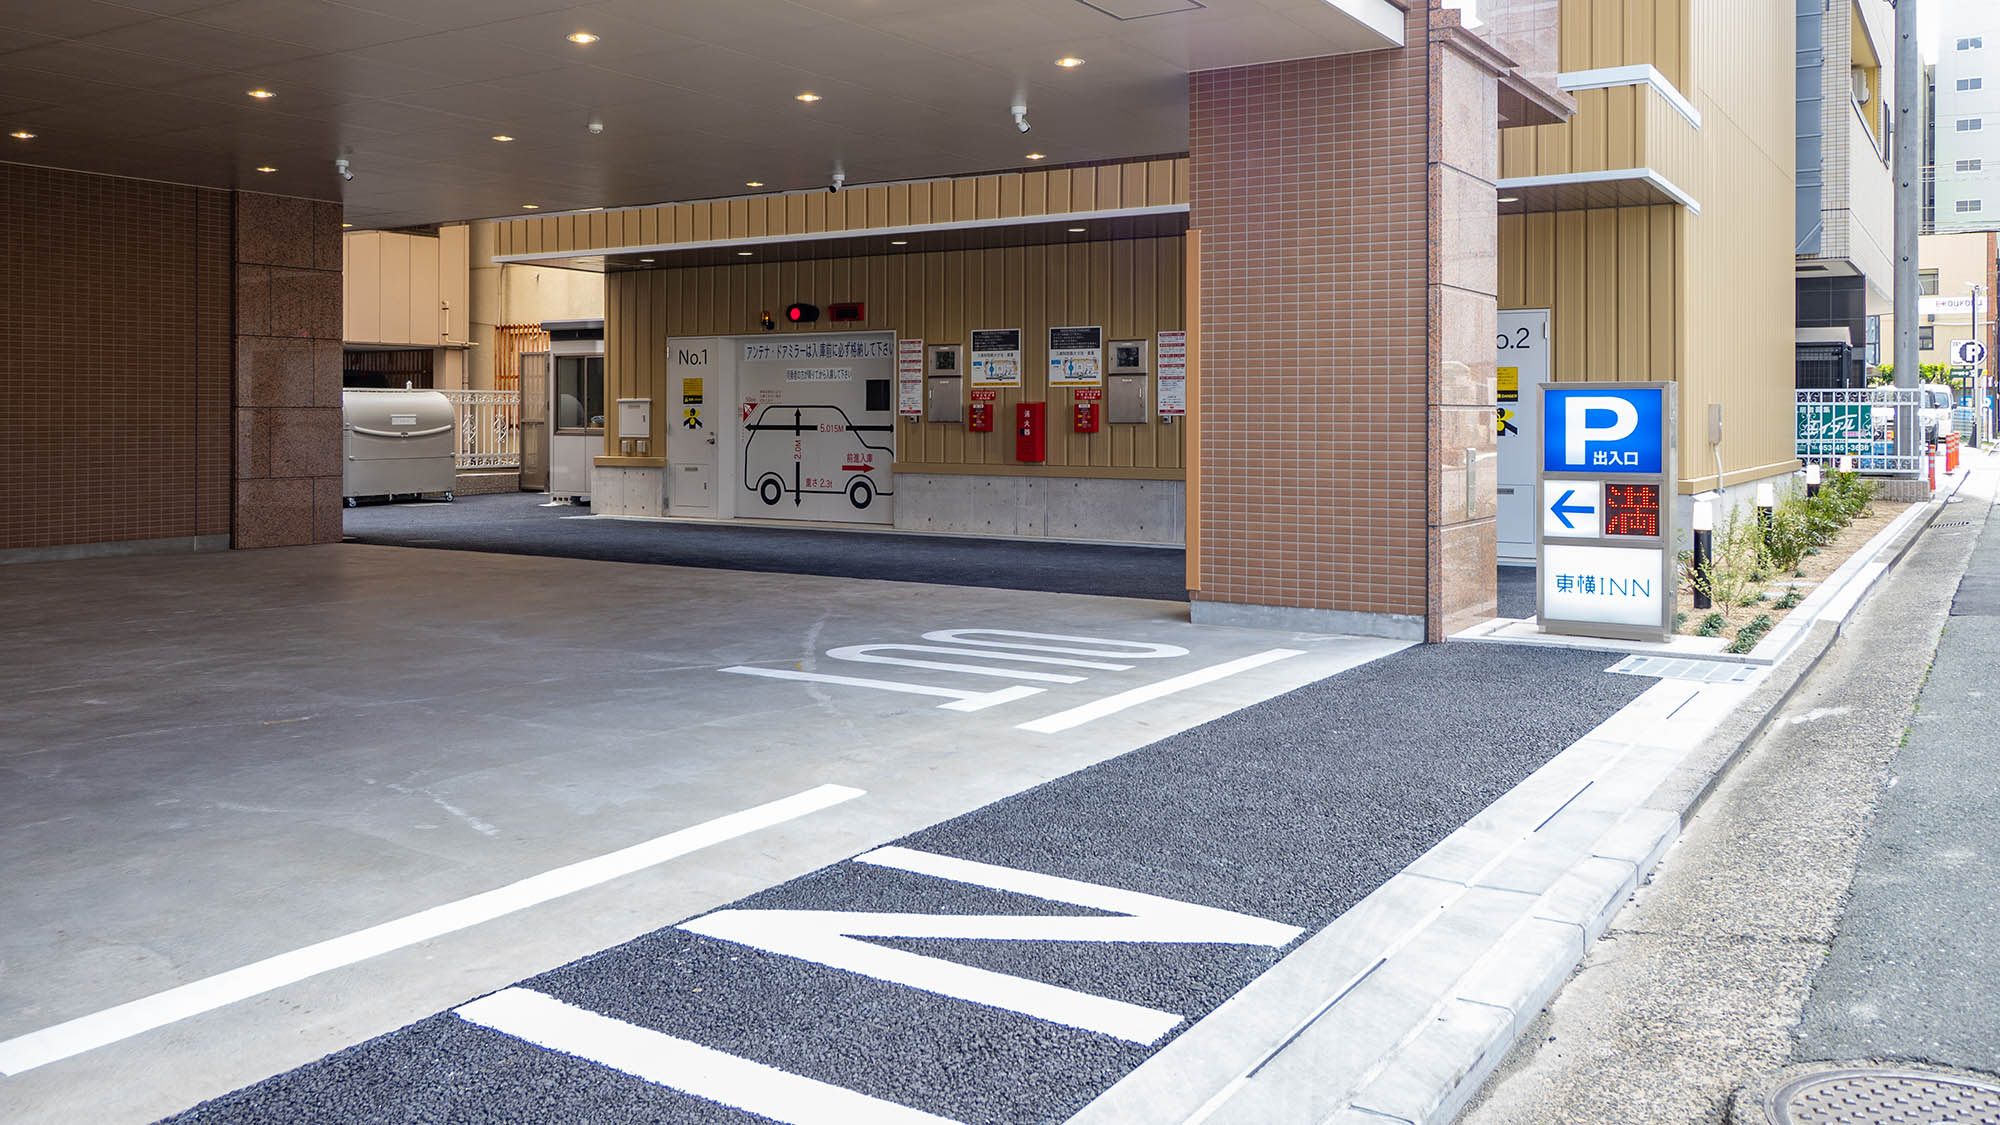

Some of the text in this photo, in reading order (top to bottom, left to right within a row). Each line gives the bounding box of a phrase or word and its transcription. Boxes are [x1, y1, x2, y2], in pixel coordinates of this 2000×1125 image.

[1496, 327, 1530, 349] o.2
[678, 348, 708, 365] No.1
[820, 424, 845, 433] 5.015M
[1565, 396, 1639, 465] P
[793, 440, 802, 460] 2.0M
[846, 453, 873, 464] 前進入庫
[1593, 451, 1639, 466] 出入口
[1608, 486, 1659, 535] 満
[1555, 574, 1651, 597] 東横INN
